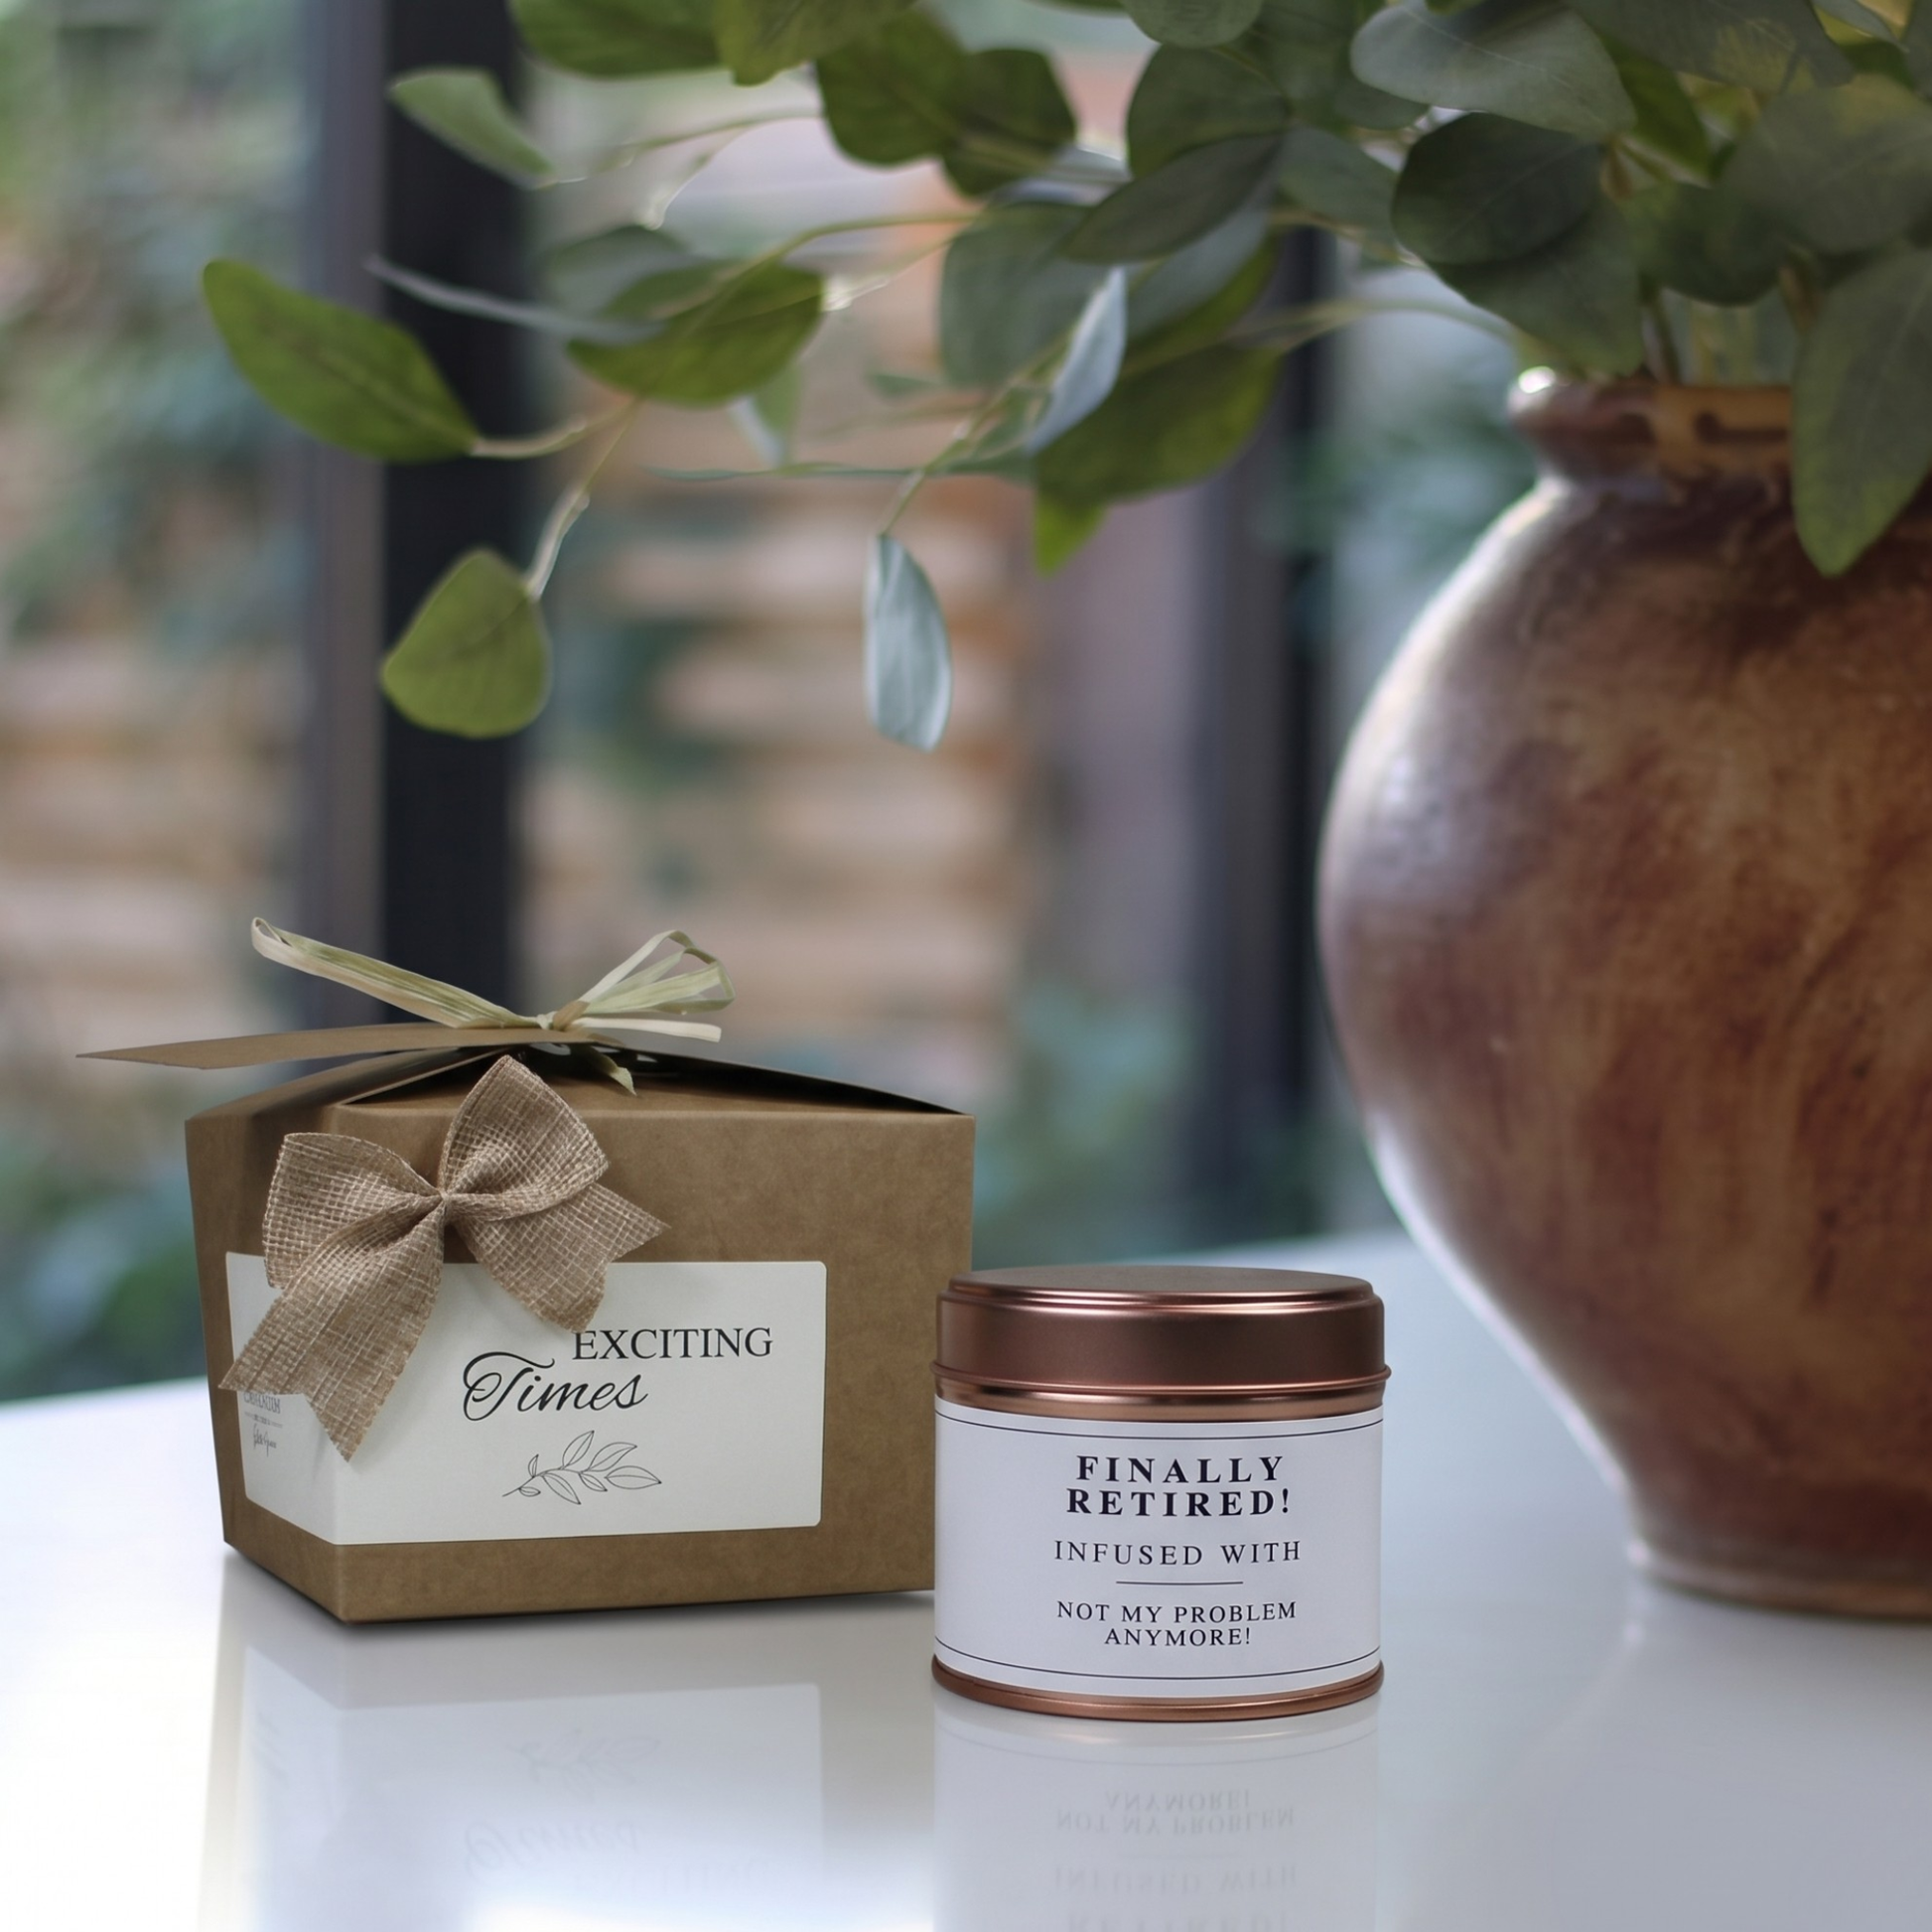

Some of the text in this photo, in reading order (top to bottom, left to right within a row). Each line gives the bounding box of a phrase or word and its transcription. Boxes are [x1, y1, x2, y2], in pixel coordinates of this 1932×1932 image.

[572, 1326, 773, 1360] EXCITING
[463, 1351, 649, 1422] Times
[1075, 1454, 1284, 1484] FINALLY
[1066, 1487, 1290, 1518] RETIRED!
[1054, 1540, 1301, 1566] INFUSED WITH
[1056, 1600, 1297, 1624] NOT MY PROBLEM
[1104, 1626, 1251, 1647] ANYMORE!
